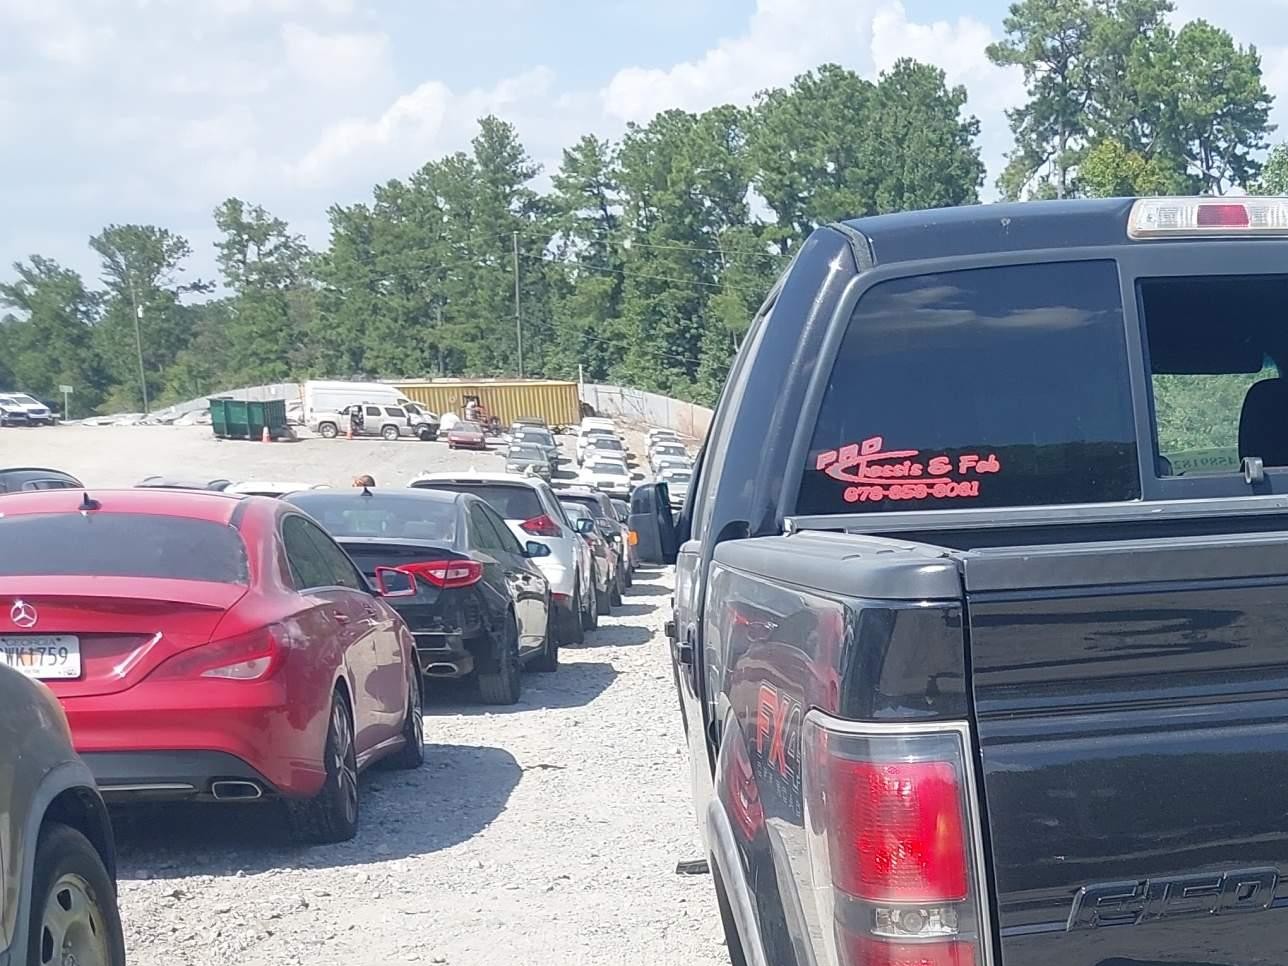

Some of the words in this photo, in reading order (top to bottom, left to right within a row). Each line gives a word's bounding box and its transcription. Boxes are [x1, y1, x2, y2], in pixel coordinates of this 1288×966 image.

[928, 456, 953, 476] &
[958, 454, 1001, 475] Fab
[0, 646, 68, 667] WK1759
